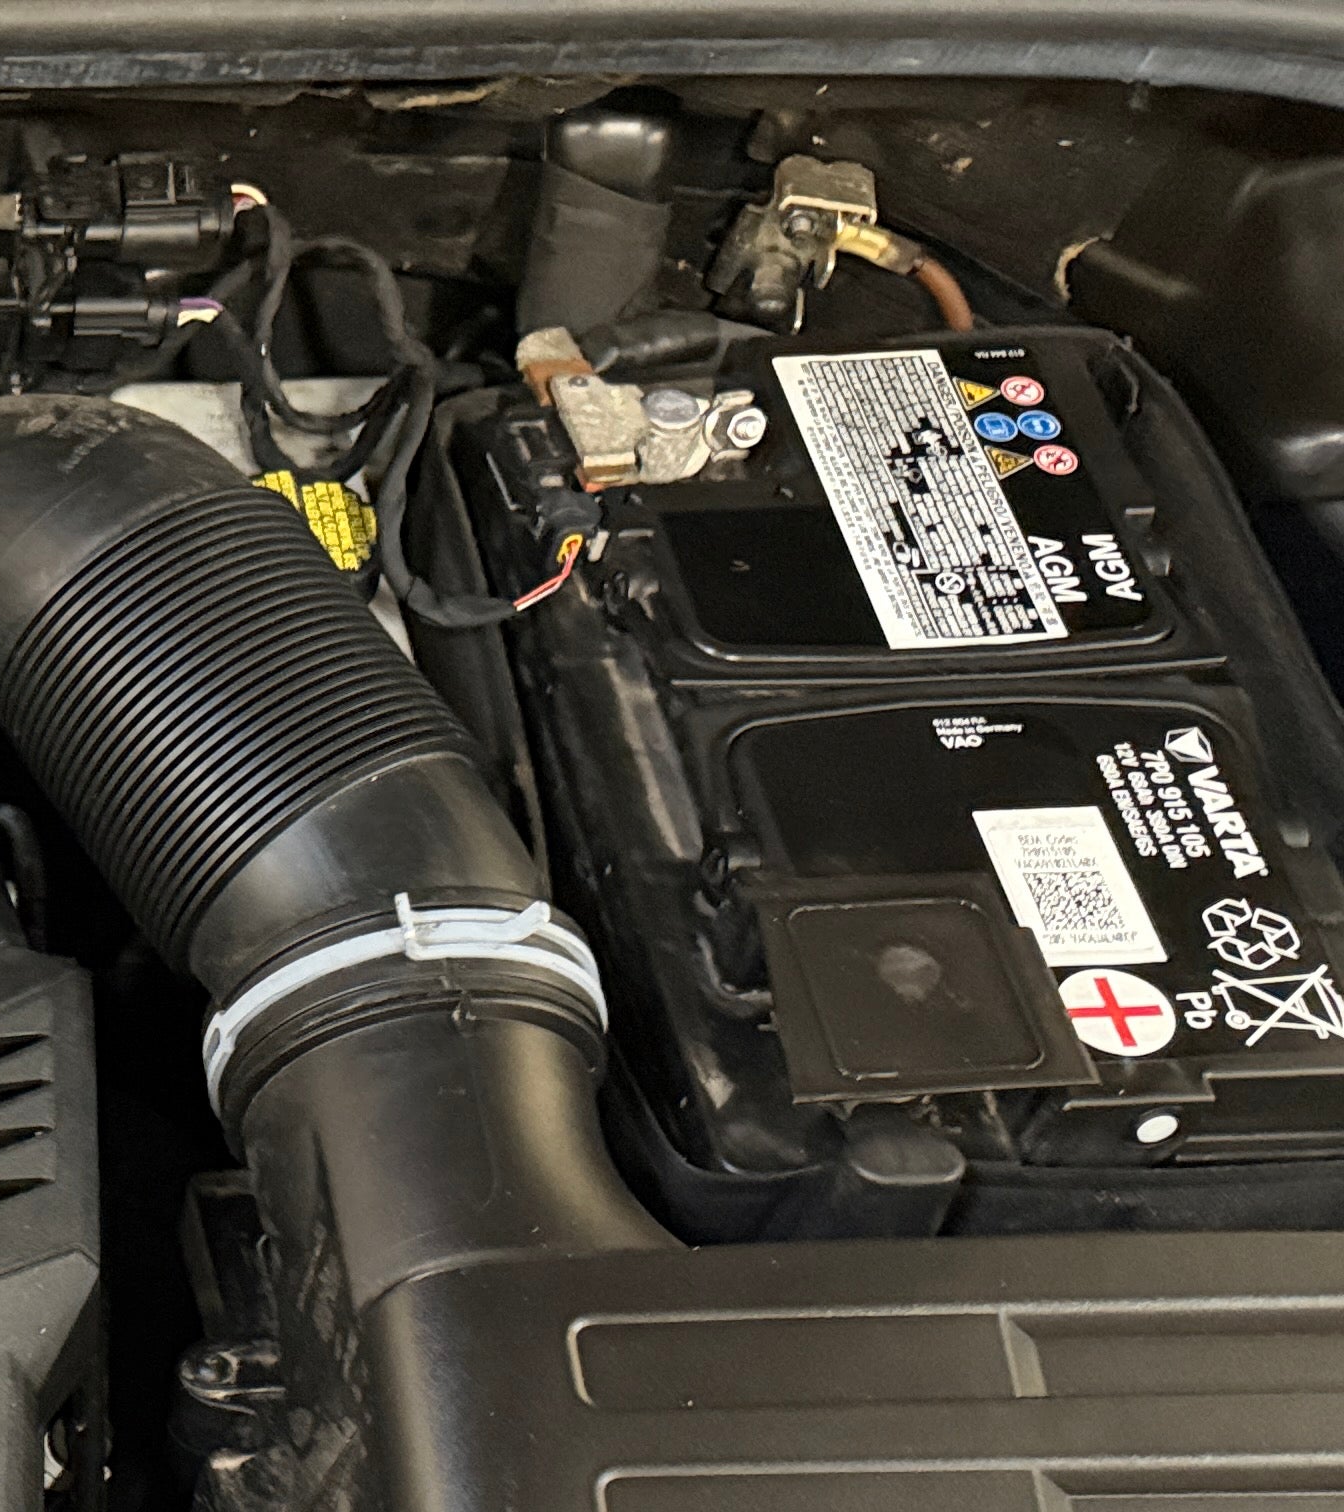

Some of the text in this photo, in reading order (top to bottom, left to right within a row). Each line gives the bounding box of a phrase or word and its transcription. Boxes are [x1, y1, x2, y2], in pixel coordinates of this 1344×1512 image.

[1027, 535, 1088, 604] AGM
[1081, 533, 1143, 602] AGM
[976, 723, 1024, 734] Germany
[1114, 742, 1140, 767] 12V
[1157, 786, 1193, 821] 915
[1176, 823, 1212, 858] 105
[1188, 765, 1266, 880] VARTA
[1175, 991, 1218, 1030] Pb
